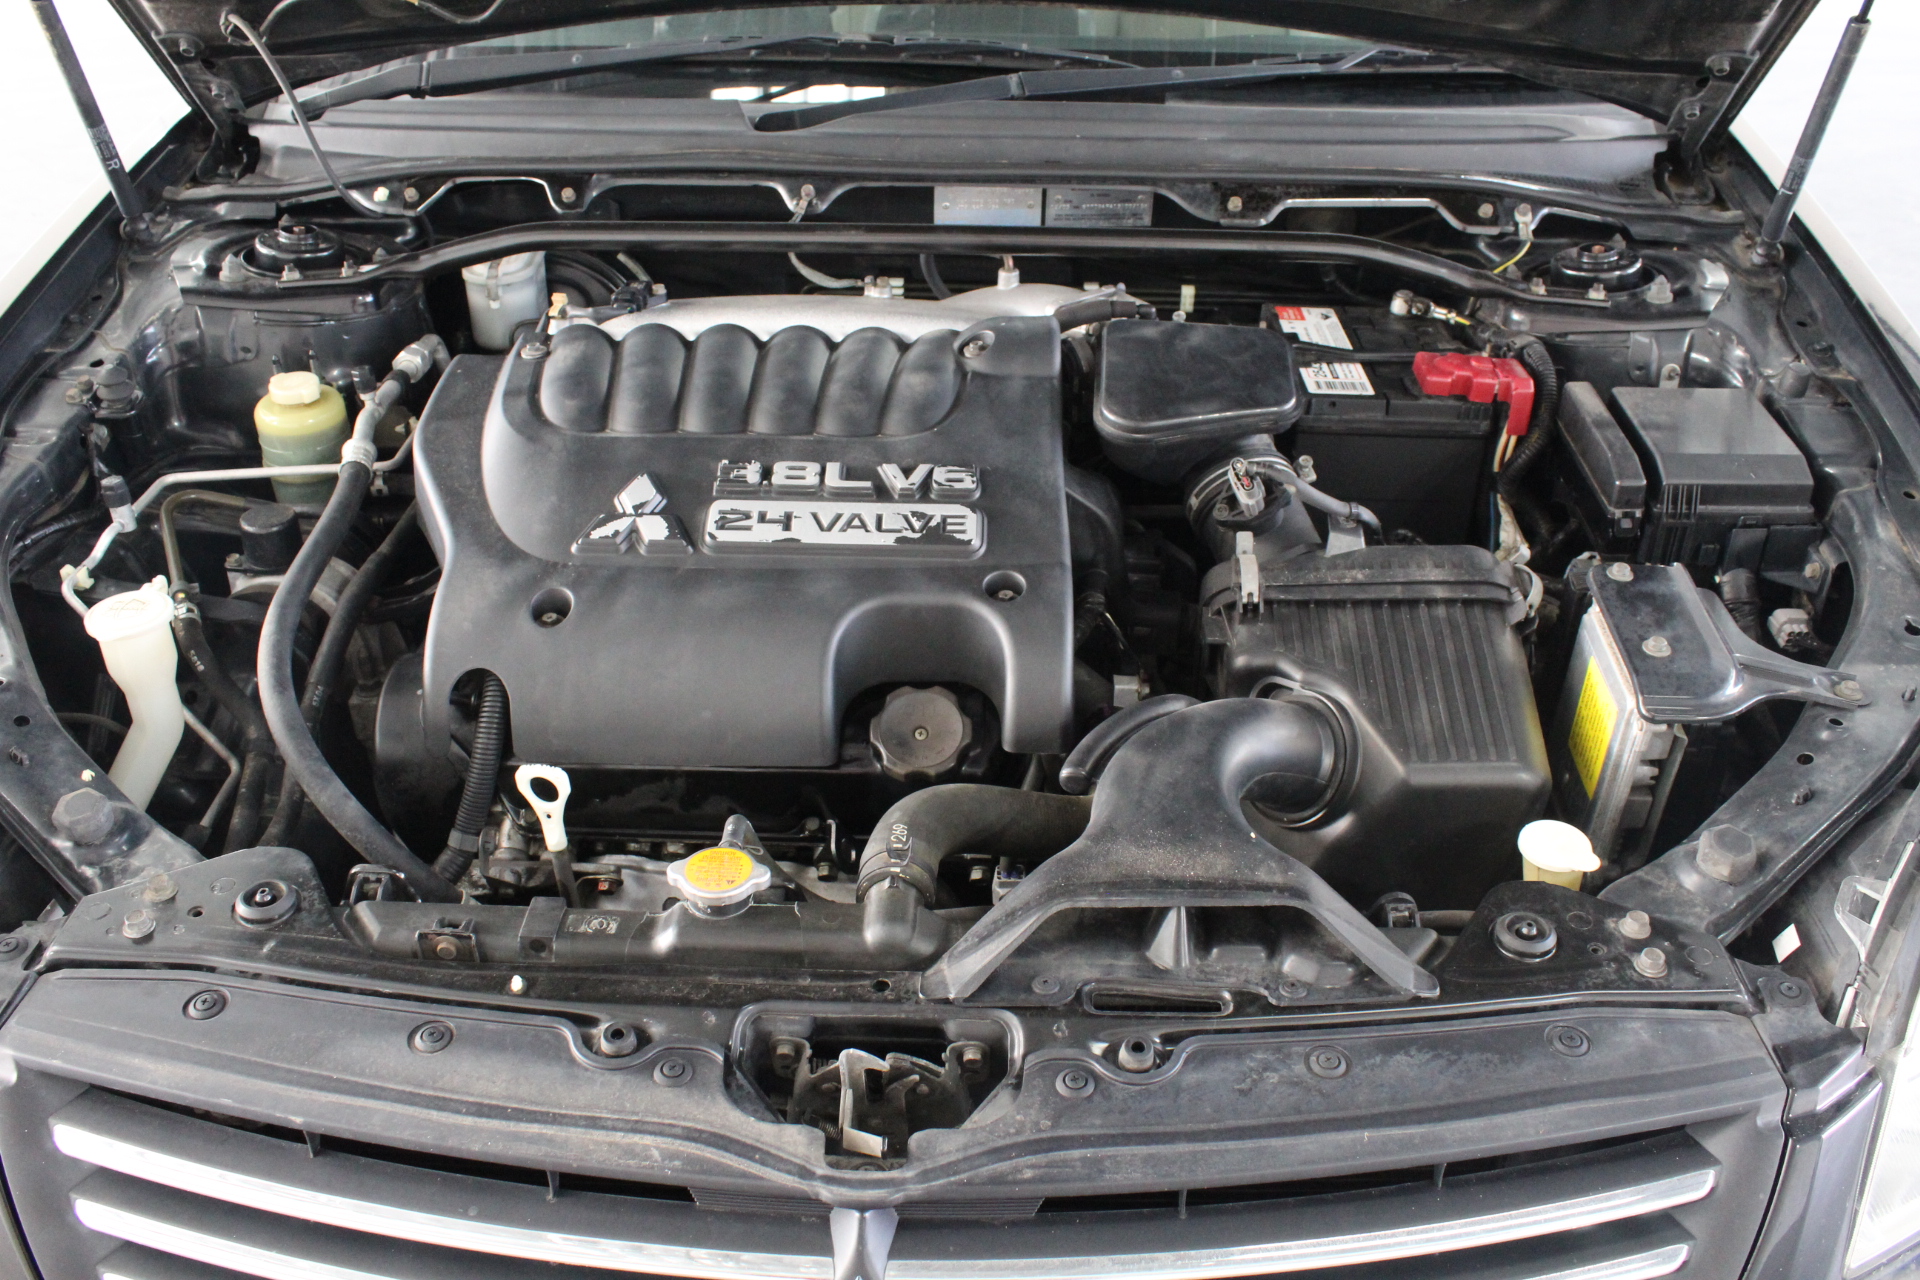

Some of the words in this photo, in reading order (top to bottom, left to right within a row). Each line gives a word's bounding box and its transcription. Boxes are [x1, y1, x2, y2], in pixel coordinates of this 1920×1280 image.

[105, 158, 120, 170] R
[1778, 187, 1794, 196] L
[713, 459, 876, 498] 3.8L
[877, 462, 981, 499] V6
[714, 508, 794, 533] 24
[808, 510, 970, 536] VALVE
[890, 823, 908, 842] 269
